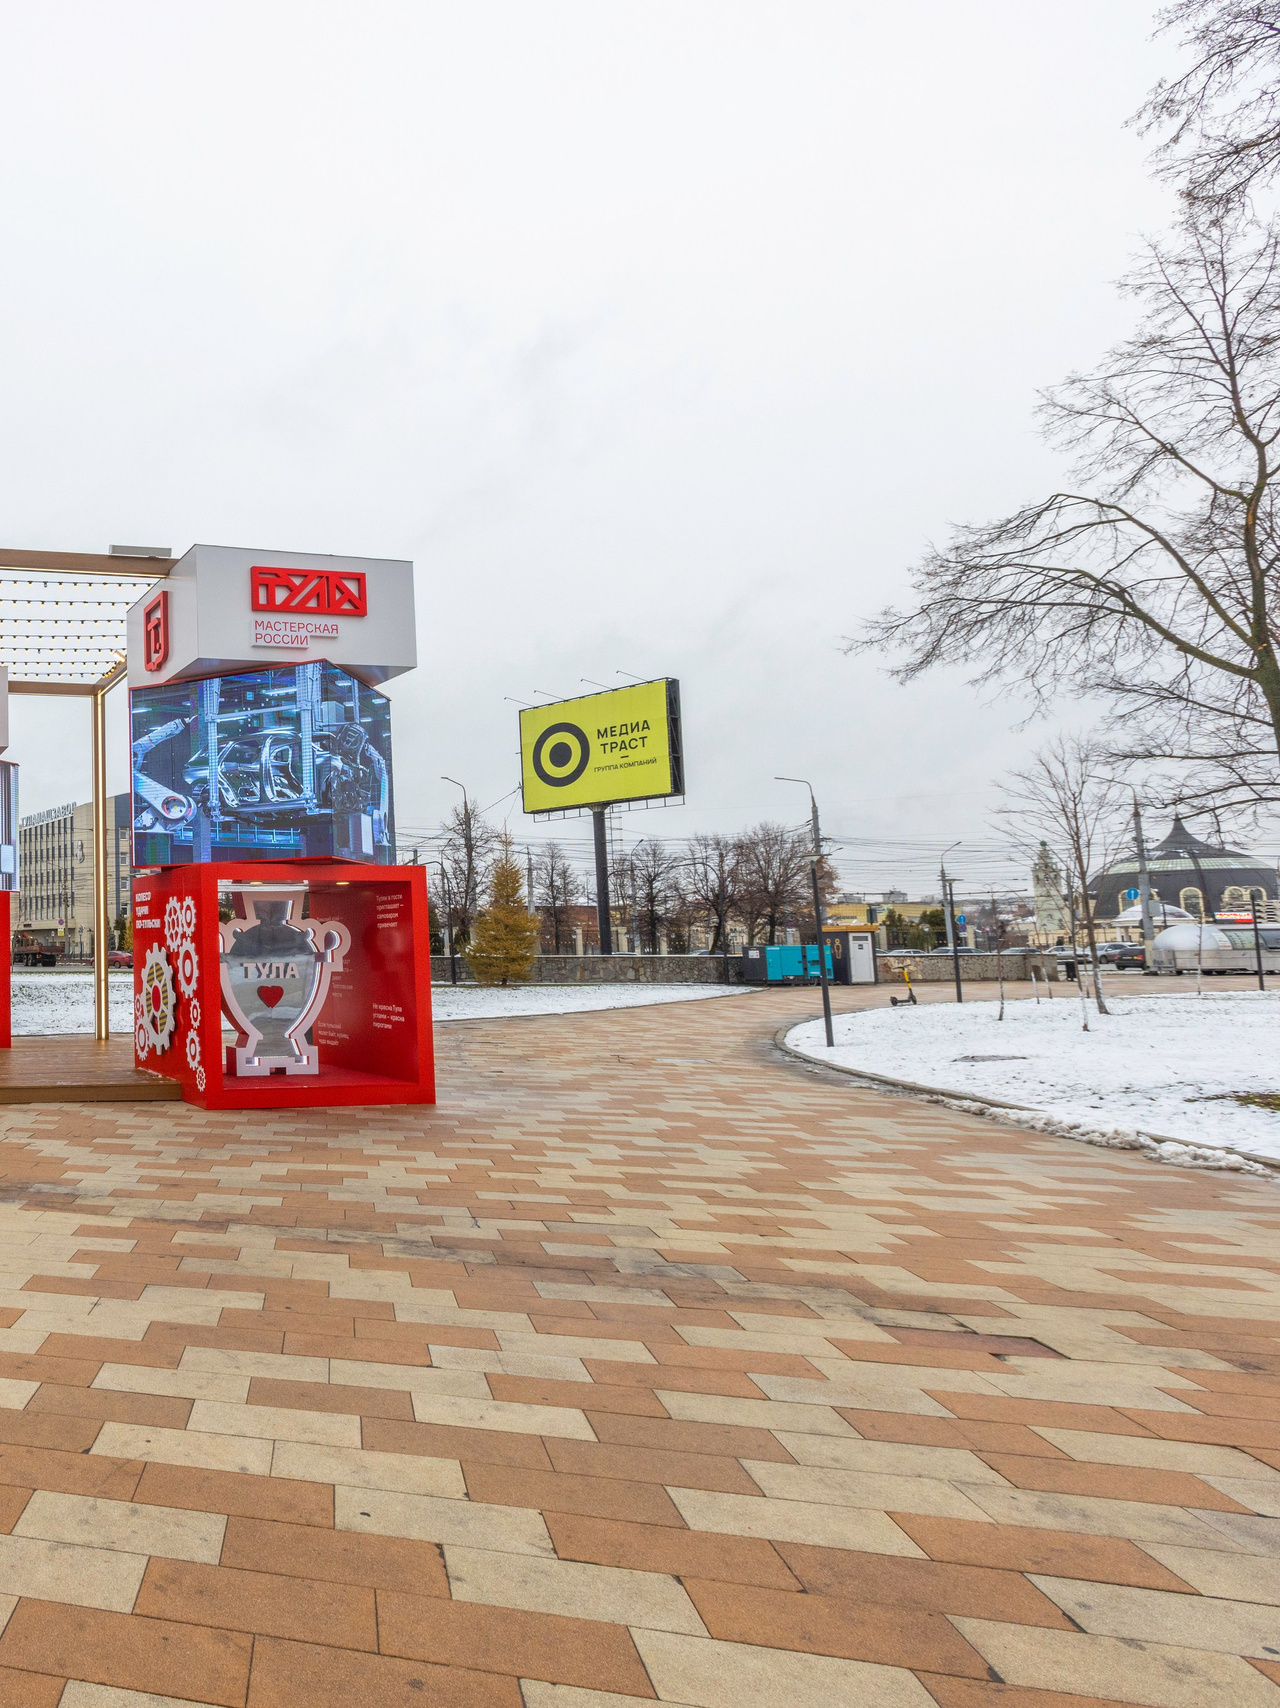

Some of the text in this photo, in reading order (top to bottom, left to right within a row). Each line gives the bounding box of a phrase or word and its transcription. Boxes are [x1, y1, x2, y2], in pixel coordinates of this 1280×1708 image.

[254, 619, 339, 635] МАСТЕРСКАЯ
[255, 633, 309, 646] РОССИИ
[597, 719, 651, 740] МЕДИА
[600, 736, 648, 755] ТРАСТ
[594, 757, 657, 773] ГРУППА КОМПАНИЙ
[241, 962, 300, 979] ТУЛА
